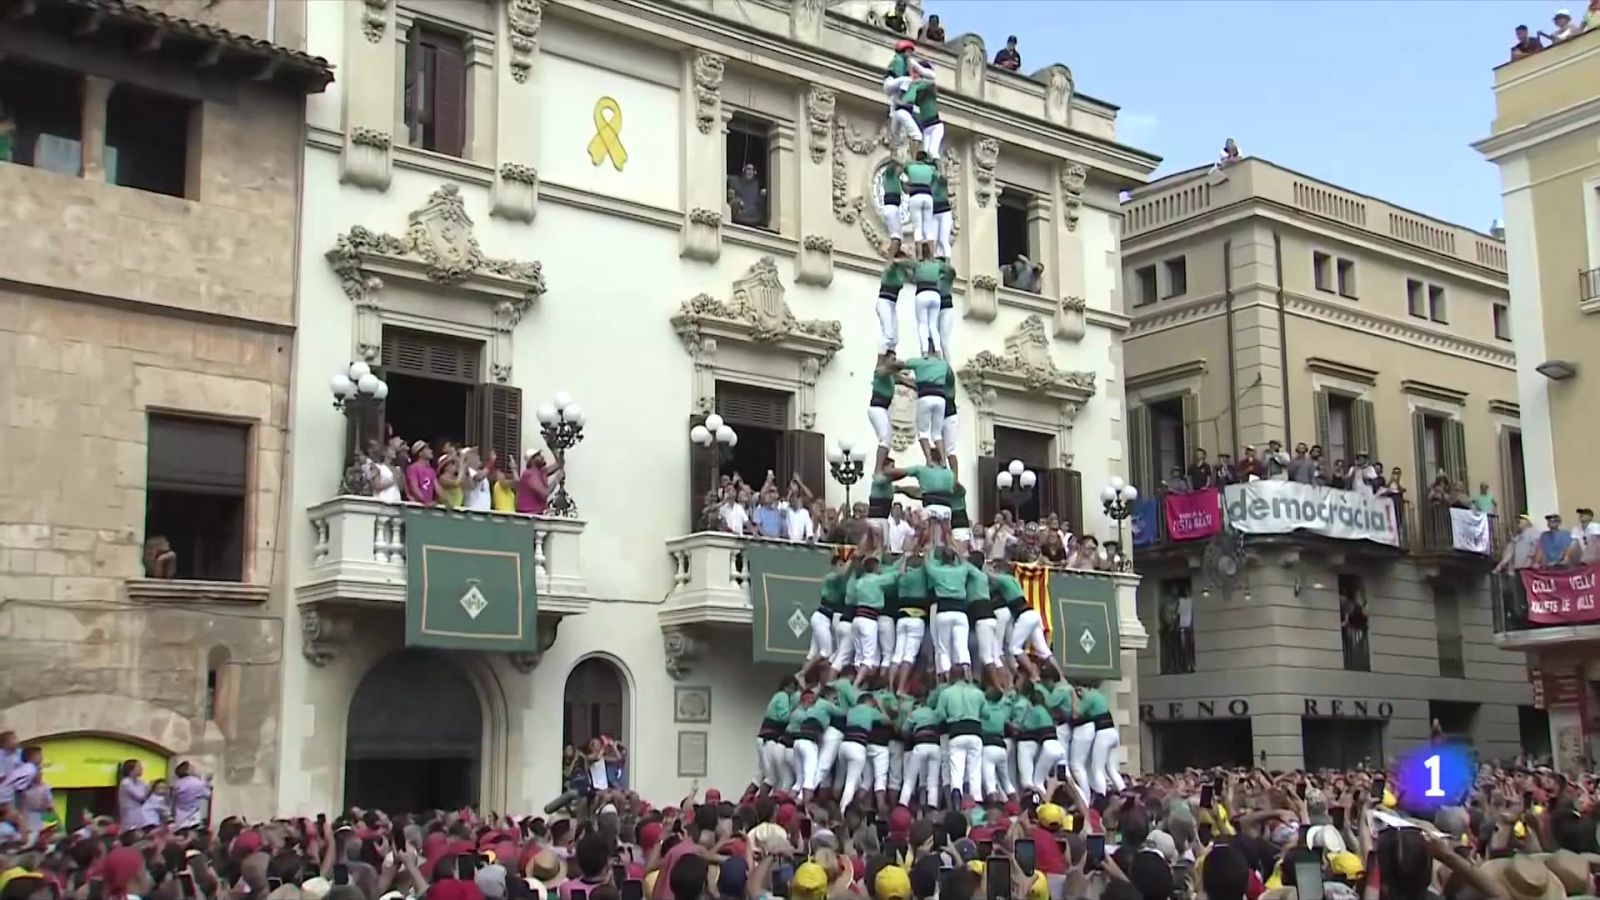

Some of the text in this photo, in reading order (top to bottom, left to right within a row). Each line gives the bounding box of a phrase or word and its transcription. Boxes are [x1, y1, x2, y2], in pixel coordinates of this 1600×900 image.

[1228, 488, 1394, 532] democràcia!
[1139, 699, 1249, 721] RENO
[1303, 698, 1394, 718] RENO
